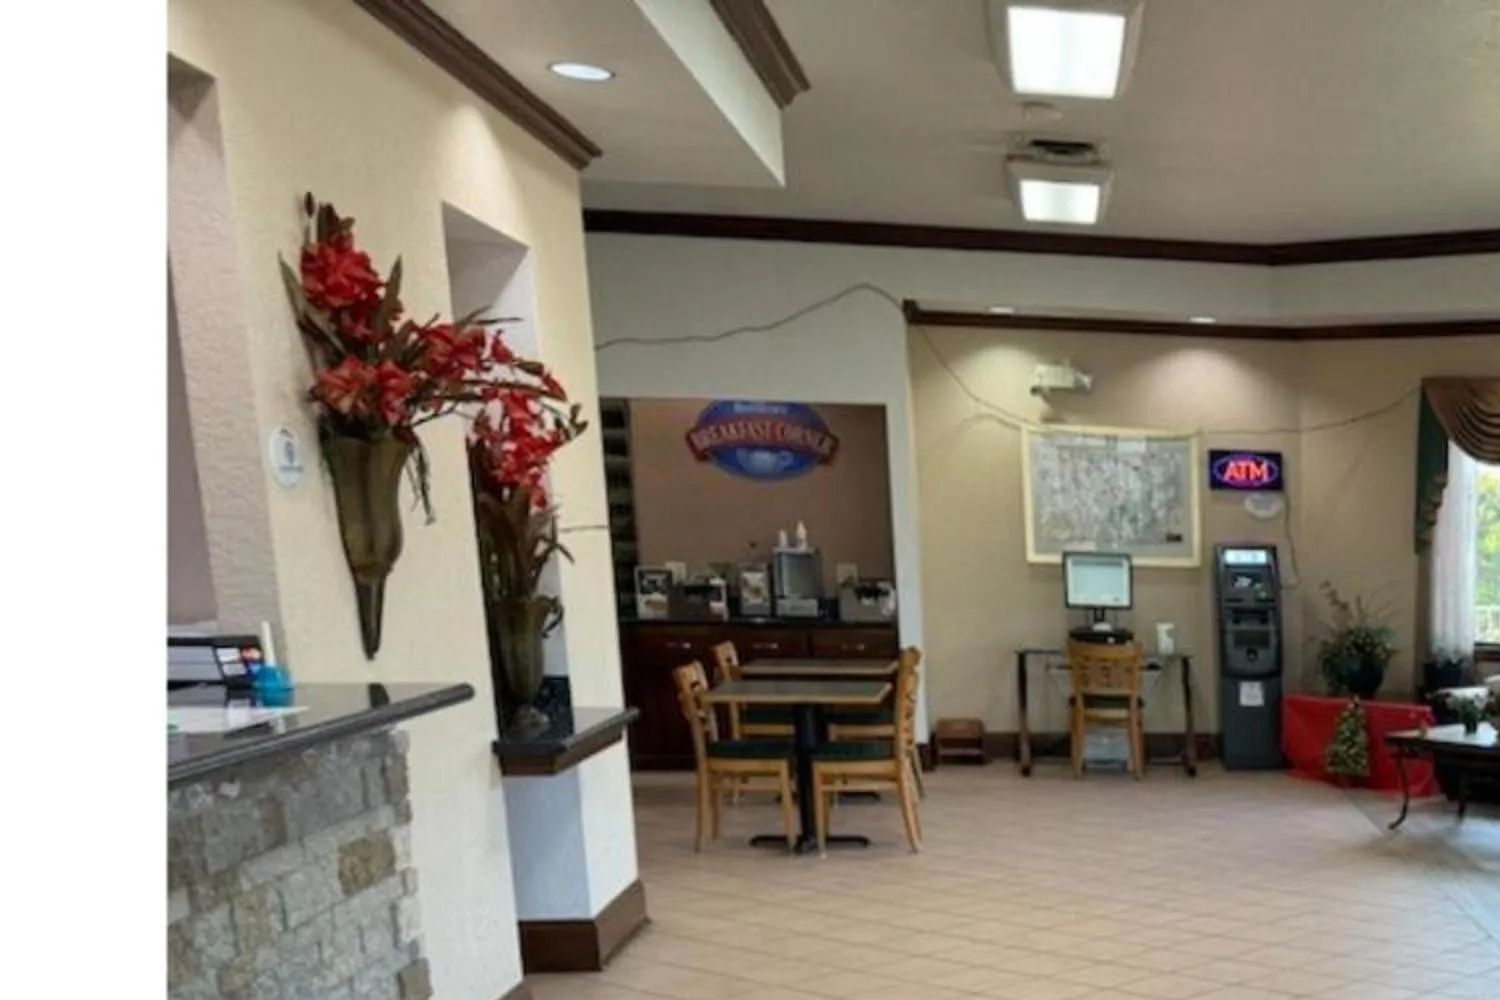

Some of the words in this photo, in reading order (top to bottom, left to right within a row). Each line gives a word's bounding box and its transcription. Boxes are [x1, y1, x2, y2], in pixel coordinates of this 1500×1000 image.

[689, 421, 770, 450] BREAKFAST
[777, 422, 834, 453] CORNER
[1223, 459, 1269, 482] ATM
